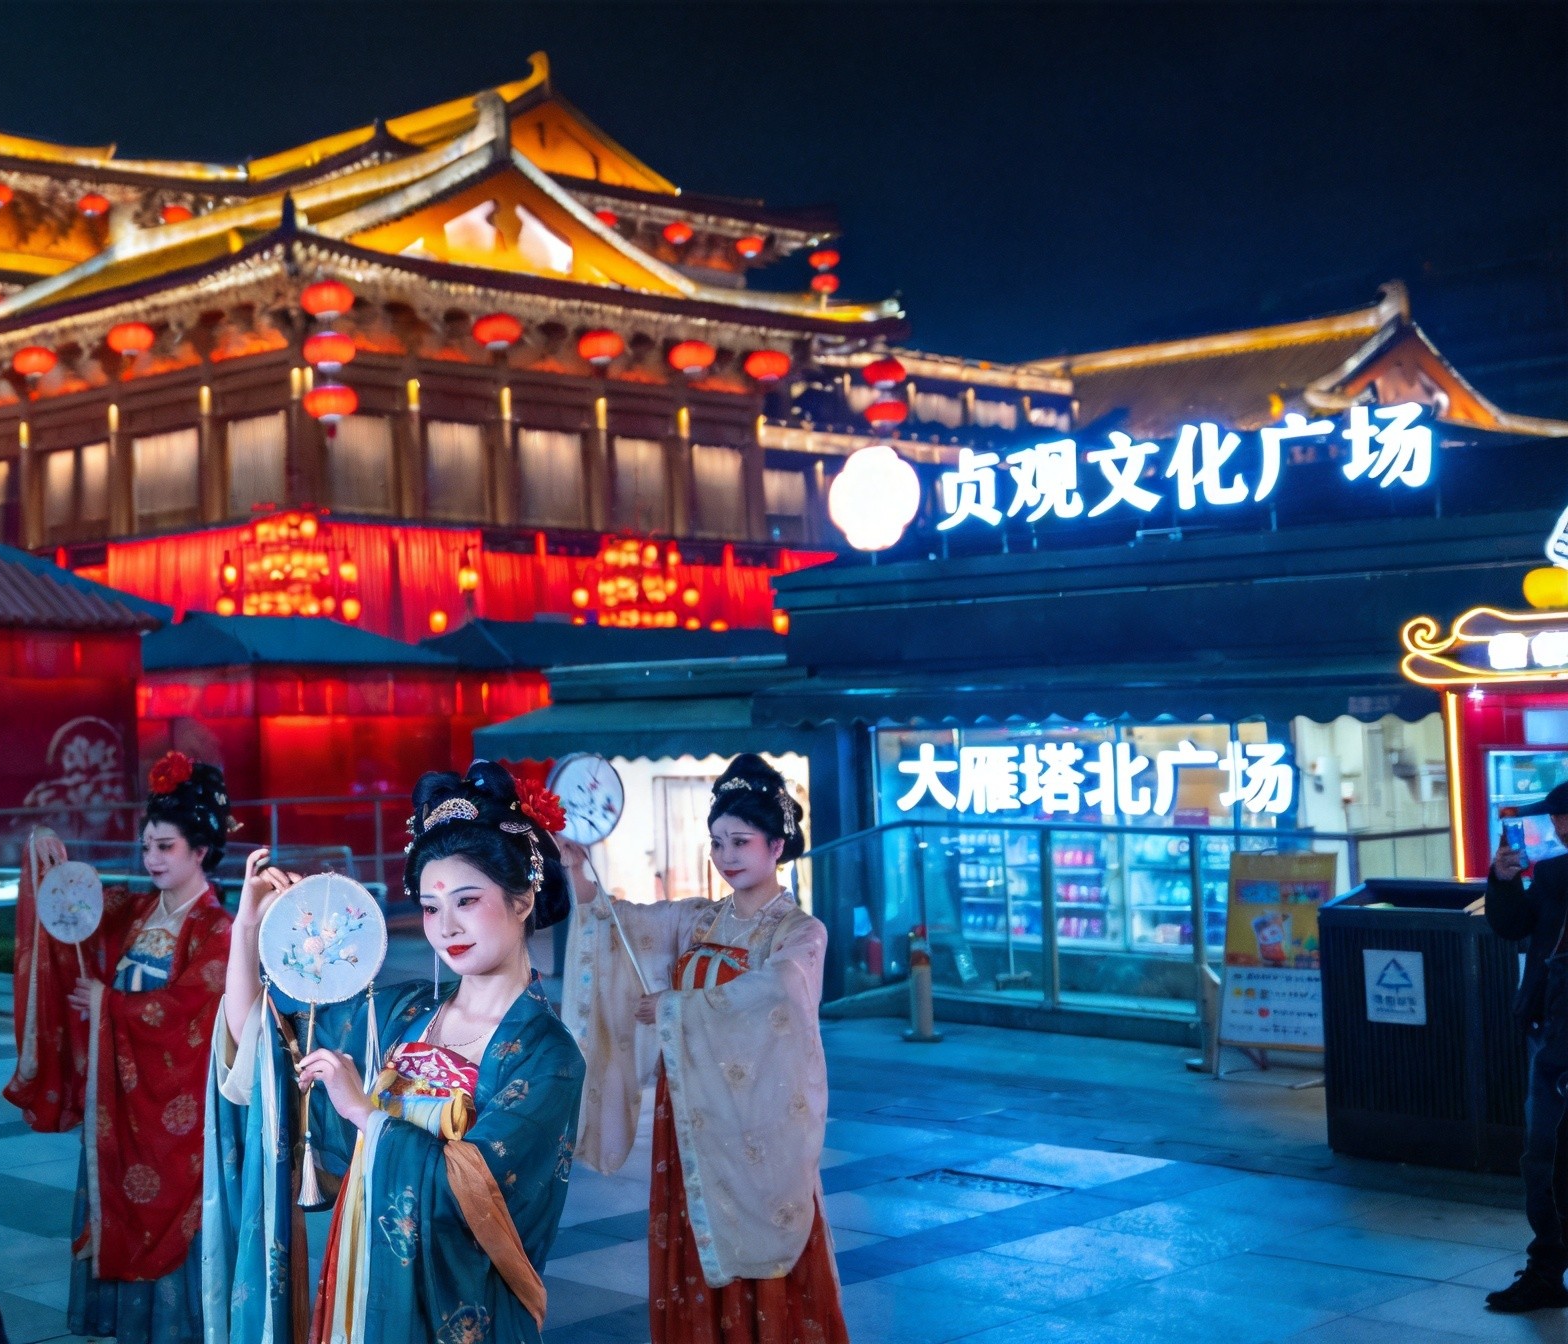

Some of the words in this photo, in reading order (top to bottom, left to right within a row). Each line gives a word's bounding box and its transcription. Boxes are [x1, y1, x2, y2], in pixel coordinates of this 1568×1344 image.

[936, 400, 1432, 531] 贞观文化广场
[897, 740, 1293, 816] 大雁塔北广场
